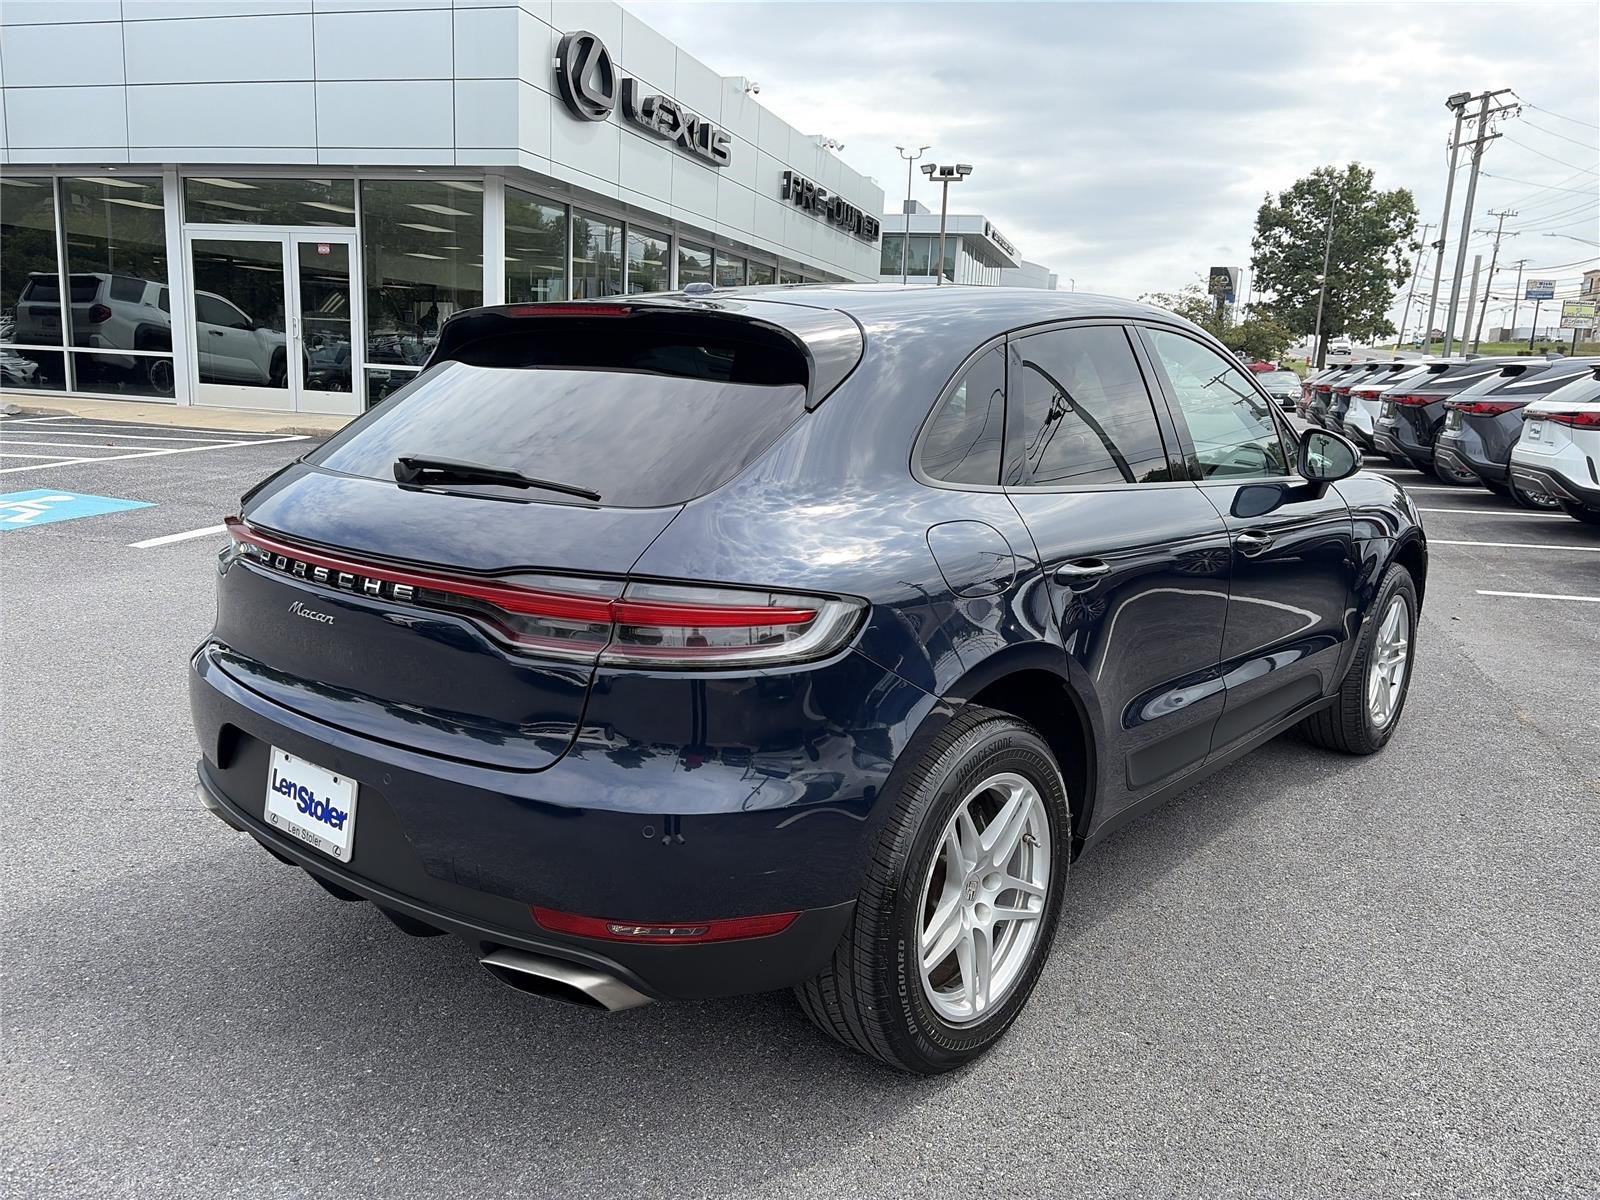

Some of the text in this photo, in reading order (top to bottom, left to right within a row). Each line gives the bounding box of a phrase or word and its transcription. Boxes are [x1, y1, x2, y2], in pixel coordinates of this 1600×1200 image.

[621, 78, 731, 167] LEXUS
[783, 171, 880, 241] PRE-OWNED
[260, 550, 414, 599] PORSCHE
[288, 600, 335, 625] Macan
[955, 736, 1012, 785] BRIDGESTONE
[287, 822, 322, 847] Len Stoler
[898, 939, 918, 1034] DRIVEGUARD
